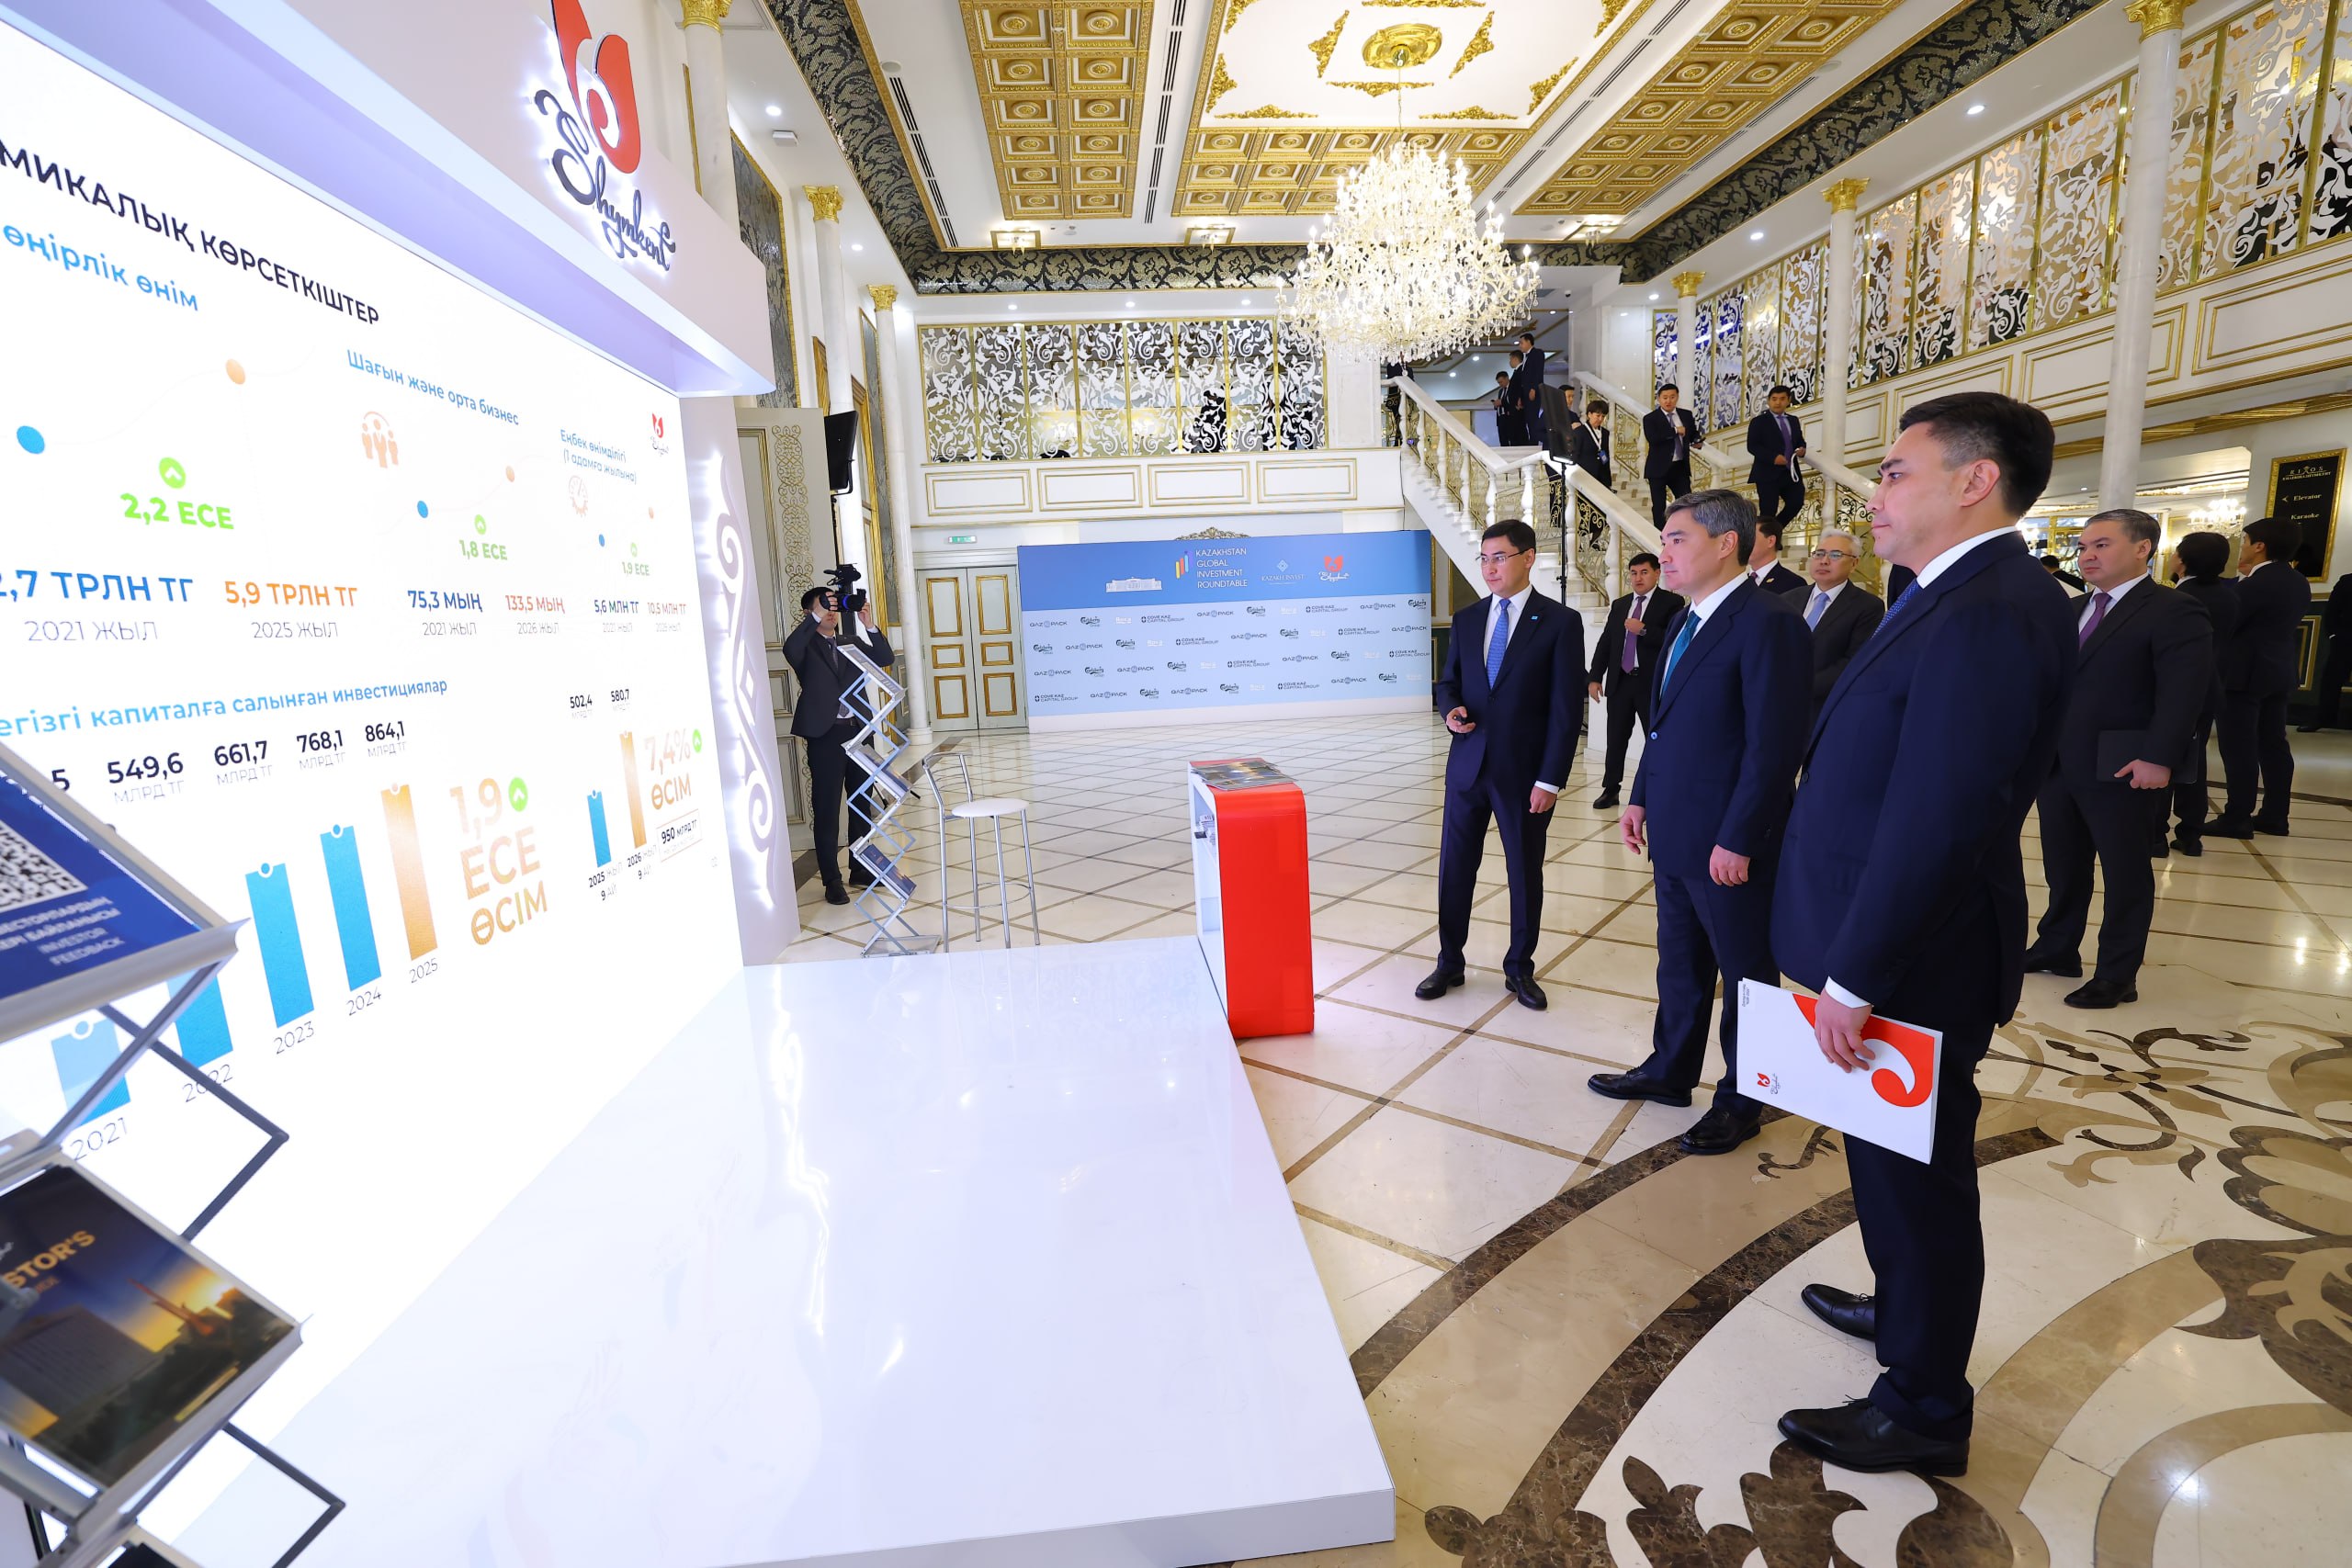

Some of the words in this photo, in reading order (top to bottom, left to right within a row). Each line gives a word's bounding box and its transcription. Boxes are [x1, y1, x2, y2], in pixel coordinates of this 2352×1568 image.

[0, 140, 195, 252] МИКАЛЫҚ
[200, 231, 379, 325] КӨРСЕТКІШТЕР
[3, 225, 128, 286] өңірлік
[137, 275, 198, 311] өнім
[346, 349, 404, 385] Шағын
[407, 374, 445, 399] және
[448, 390, 477, 412] орта
[479, 399, 520, 426] бизнес
[560, 429, 588, 449] Еңбек
[119, 492, 170, 525] 2,2
[177, 501, 234, 530] ЕСЕ
[458, 539, 479, 559] 1,8
[481, 542, 508, 561] ЕСЕ
[1195, 547, 1247, 557] KAZAKHSTAN
[621, 561, 634, 575] 1,9
[635, 564, 650, 577] ЕСЕ
[1197, 559, 1228, 568] GLOBAL
[1197, 570, 1243, 578] INVESTMENT
[51, 571, 152, 602] ТРЛН
[158, 577, 194, 603] ТГ
[224, 581, 261, 608] 5,9
[266, 583, 330, 607] ТРЛН
[334, 587, 358, 607] ТГ
[1197, 580, 1248, 588] ROUNDTABLE
[407, 590, 440, 612] 75,3
[443, 592, 483, 613] МЫҢ
[505, 594, 534, 613] 133,5
[536, 596, 566, 615] МЫҢ
[594, 599, 607, 615] 5,6
[609, 600, 628, 614] МЛН
[630, 601, 639, 614] ТГ
[647, 602, 662, 615] 10,5
[662, 603, 679, 615] МЛН
[24, 621, 85, 641] 2021
[92, 621, 159, 641] ЖЫЛ
[251, 622, 293, 639] 2025
[297, 622, 339, 638] ЖЫЛ
[422, 622, 447, 636] 2021
[449, 622, 477, 636] ЖЫЛ
[91, 696, 227, 728] капиталға
[232, 690, 329, 714] салынған
[332, 678, 448, 705] инвестициялар
[570, 694, 593, 709] 502,4
[611, 689, 629, 703] 580,7
[296, 729, 345, 754] 768,1
[365, 721, 405, 744] 864,1
[213, 740, 269, 768] 661,7
[644, 728, 691, 775] 7,4%
[107, 752, 184, 785] 549,6
[650, 773, 692, 811] ӨСІМ
[449, 778, 503, 840] 1,9
[661, 827, 675, 844] 950
[460, 826, 541, 901] ЕСЕ
[588, 871, 605, 888] 2025
[470, 880, 548, 946] ӨСІМ
[408, 957, 439, 984] 2025
[346, 987, 382, 1017] 2024
[273, 1021, 315, 1055] 2023
[70, 1117, 129, 1161] 2021
